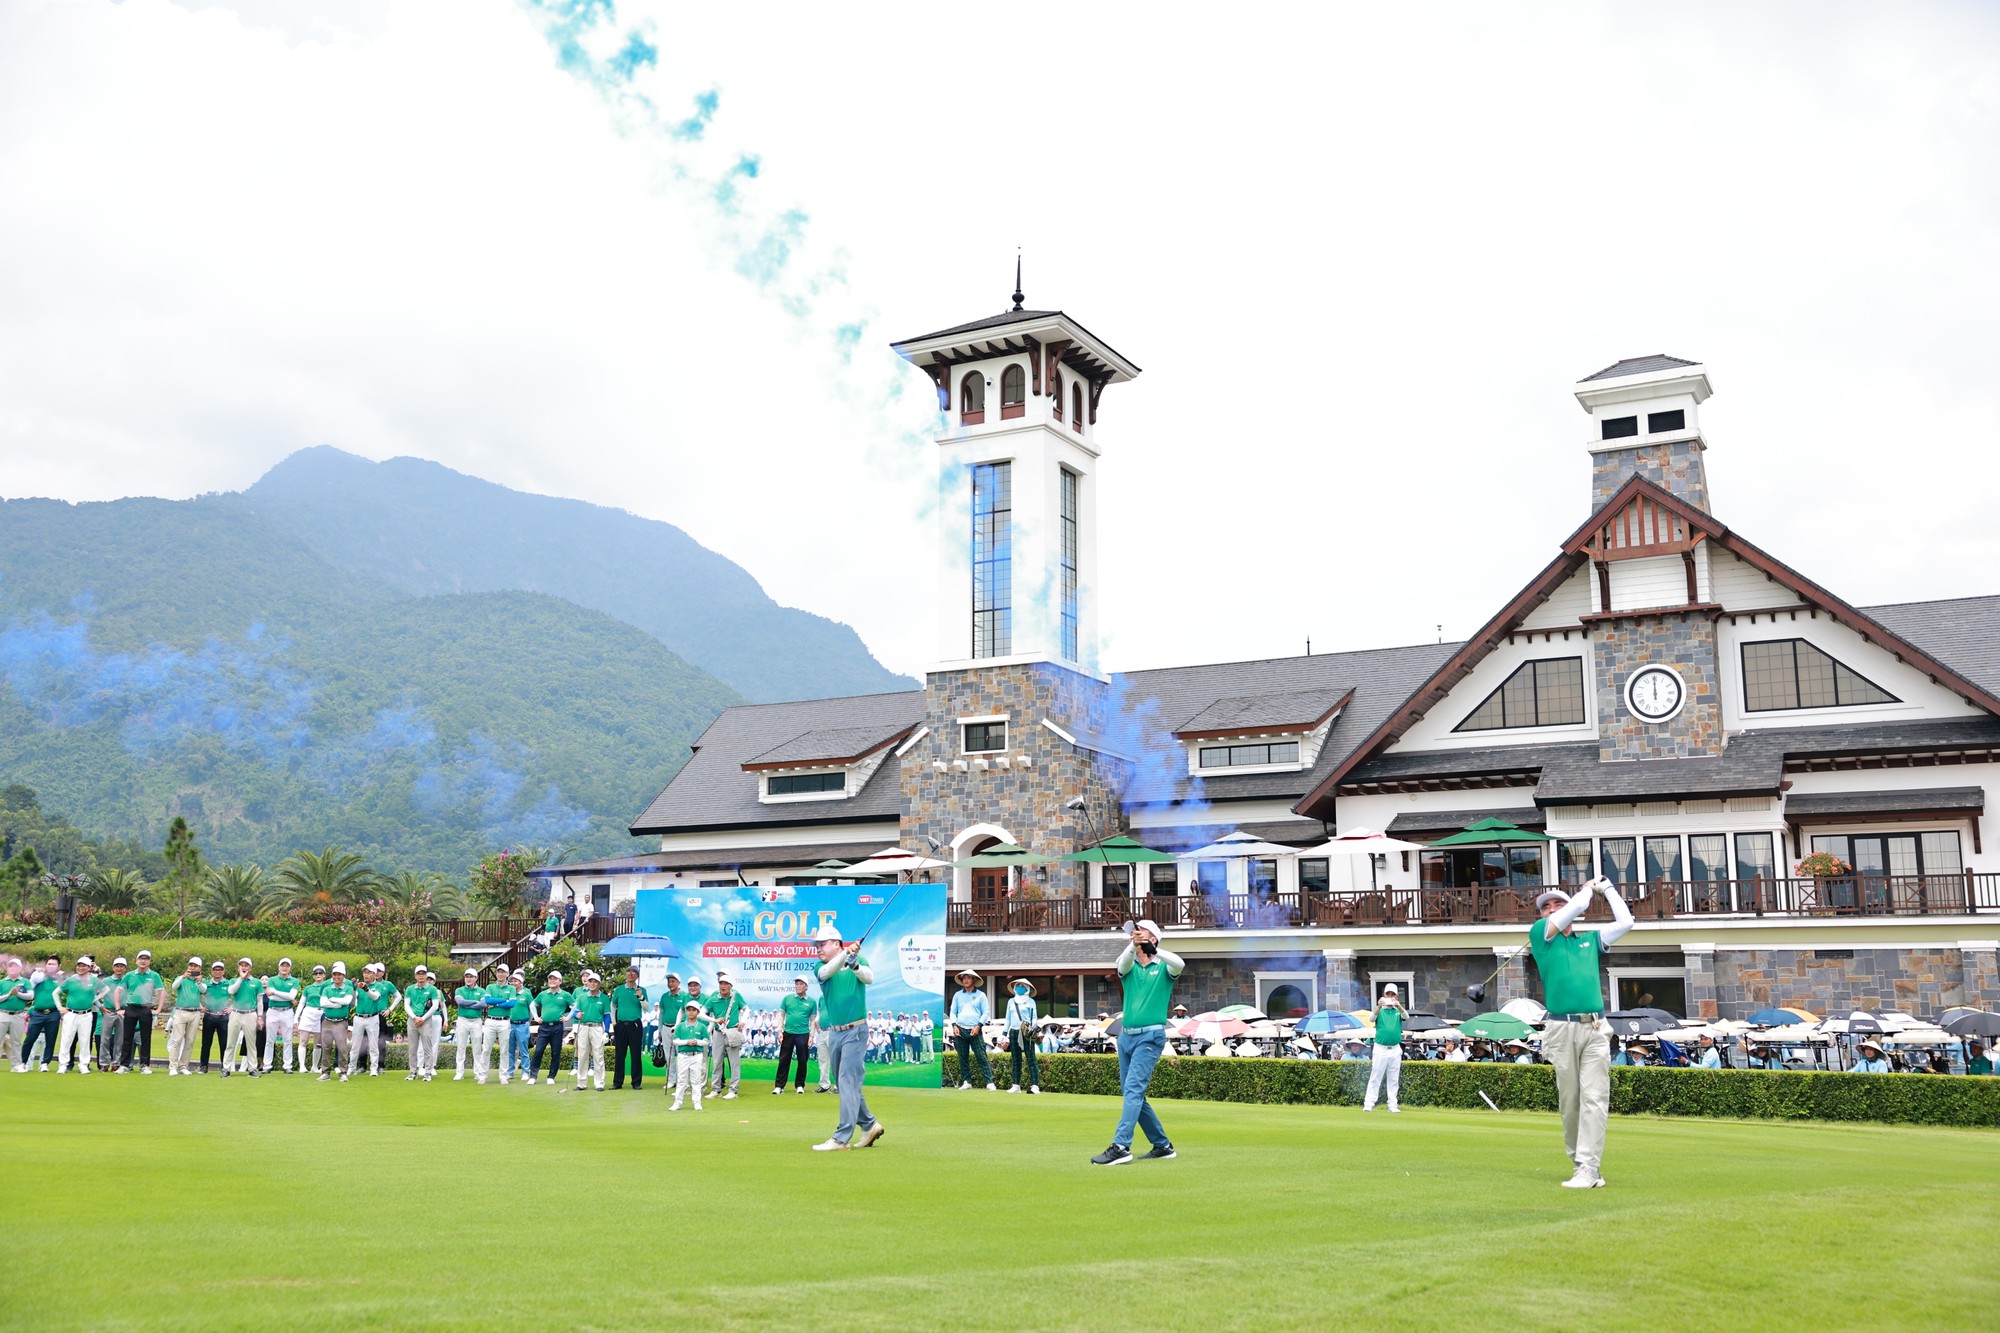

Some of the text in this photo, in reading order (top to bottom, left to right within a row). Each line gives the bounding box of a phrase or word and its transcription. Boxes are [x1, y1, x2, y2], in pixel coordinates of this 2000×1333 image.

[723, 919, 751, 937] Giải
[787, 944, 804, 955] CÚP
[763, 961, 784, 971] THỨ
[785, 963, 792, 971] II
[794, 963, 815, 971] 2025
